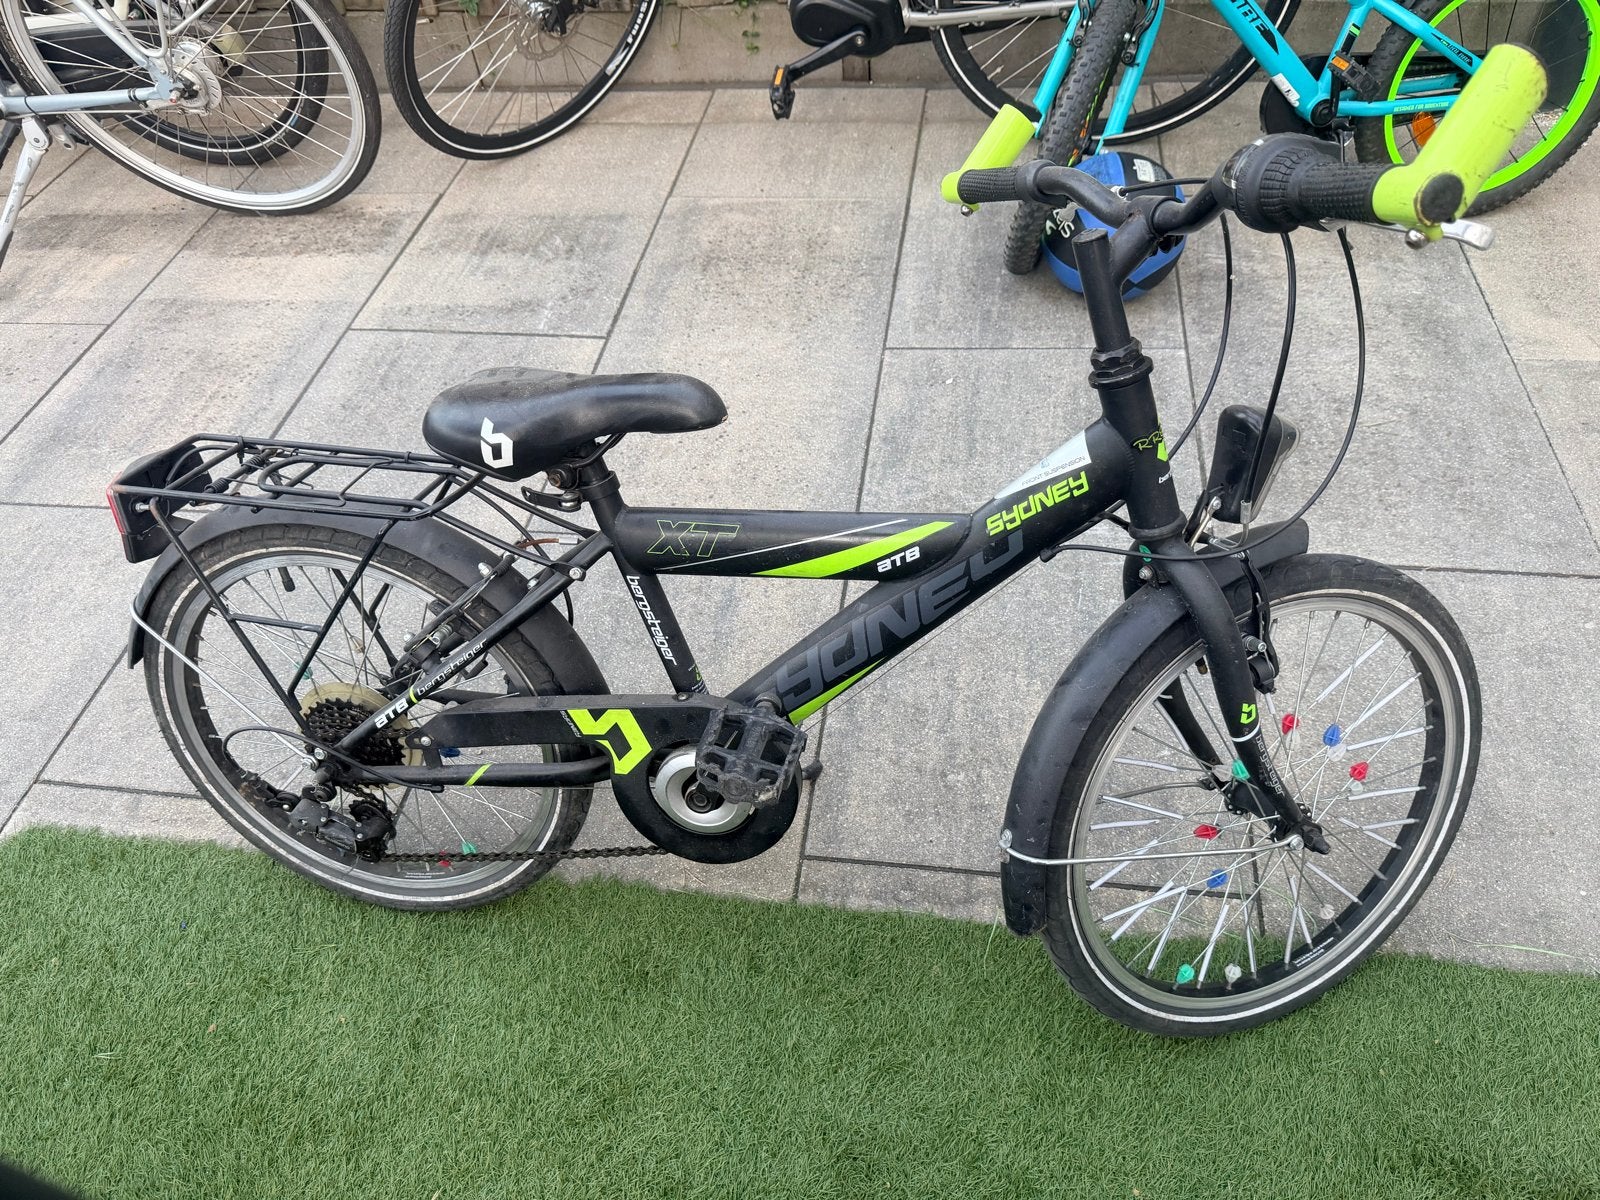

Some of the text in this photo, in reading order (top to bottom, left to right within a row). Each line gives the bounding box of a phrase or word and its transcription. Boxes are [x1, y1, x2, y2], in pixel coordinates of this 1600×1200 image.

[1021, 455, 1086, 486] FRONT SUSPENSION
[647, 519, 740, 557] XT
[626, 575, 678, 666] bergsteiger
[417, 638, 488, 696] bergsteiger
[1255, 733, 1285, 798] bergsteiger
